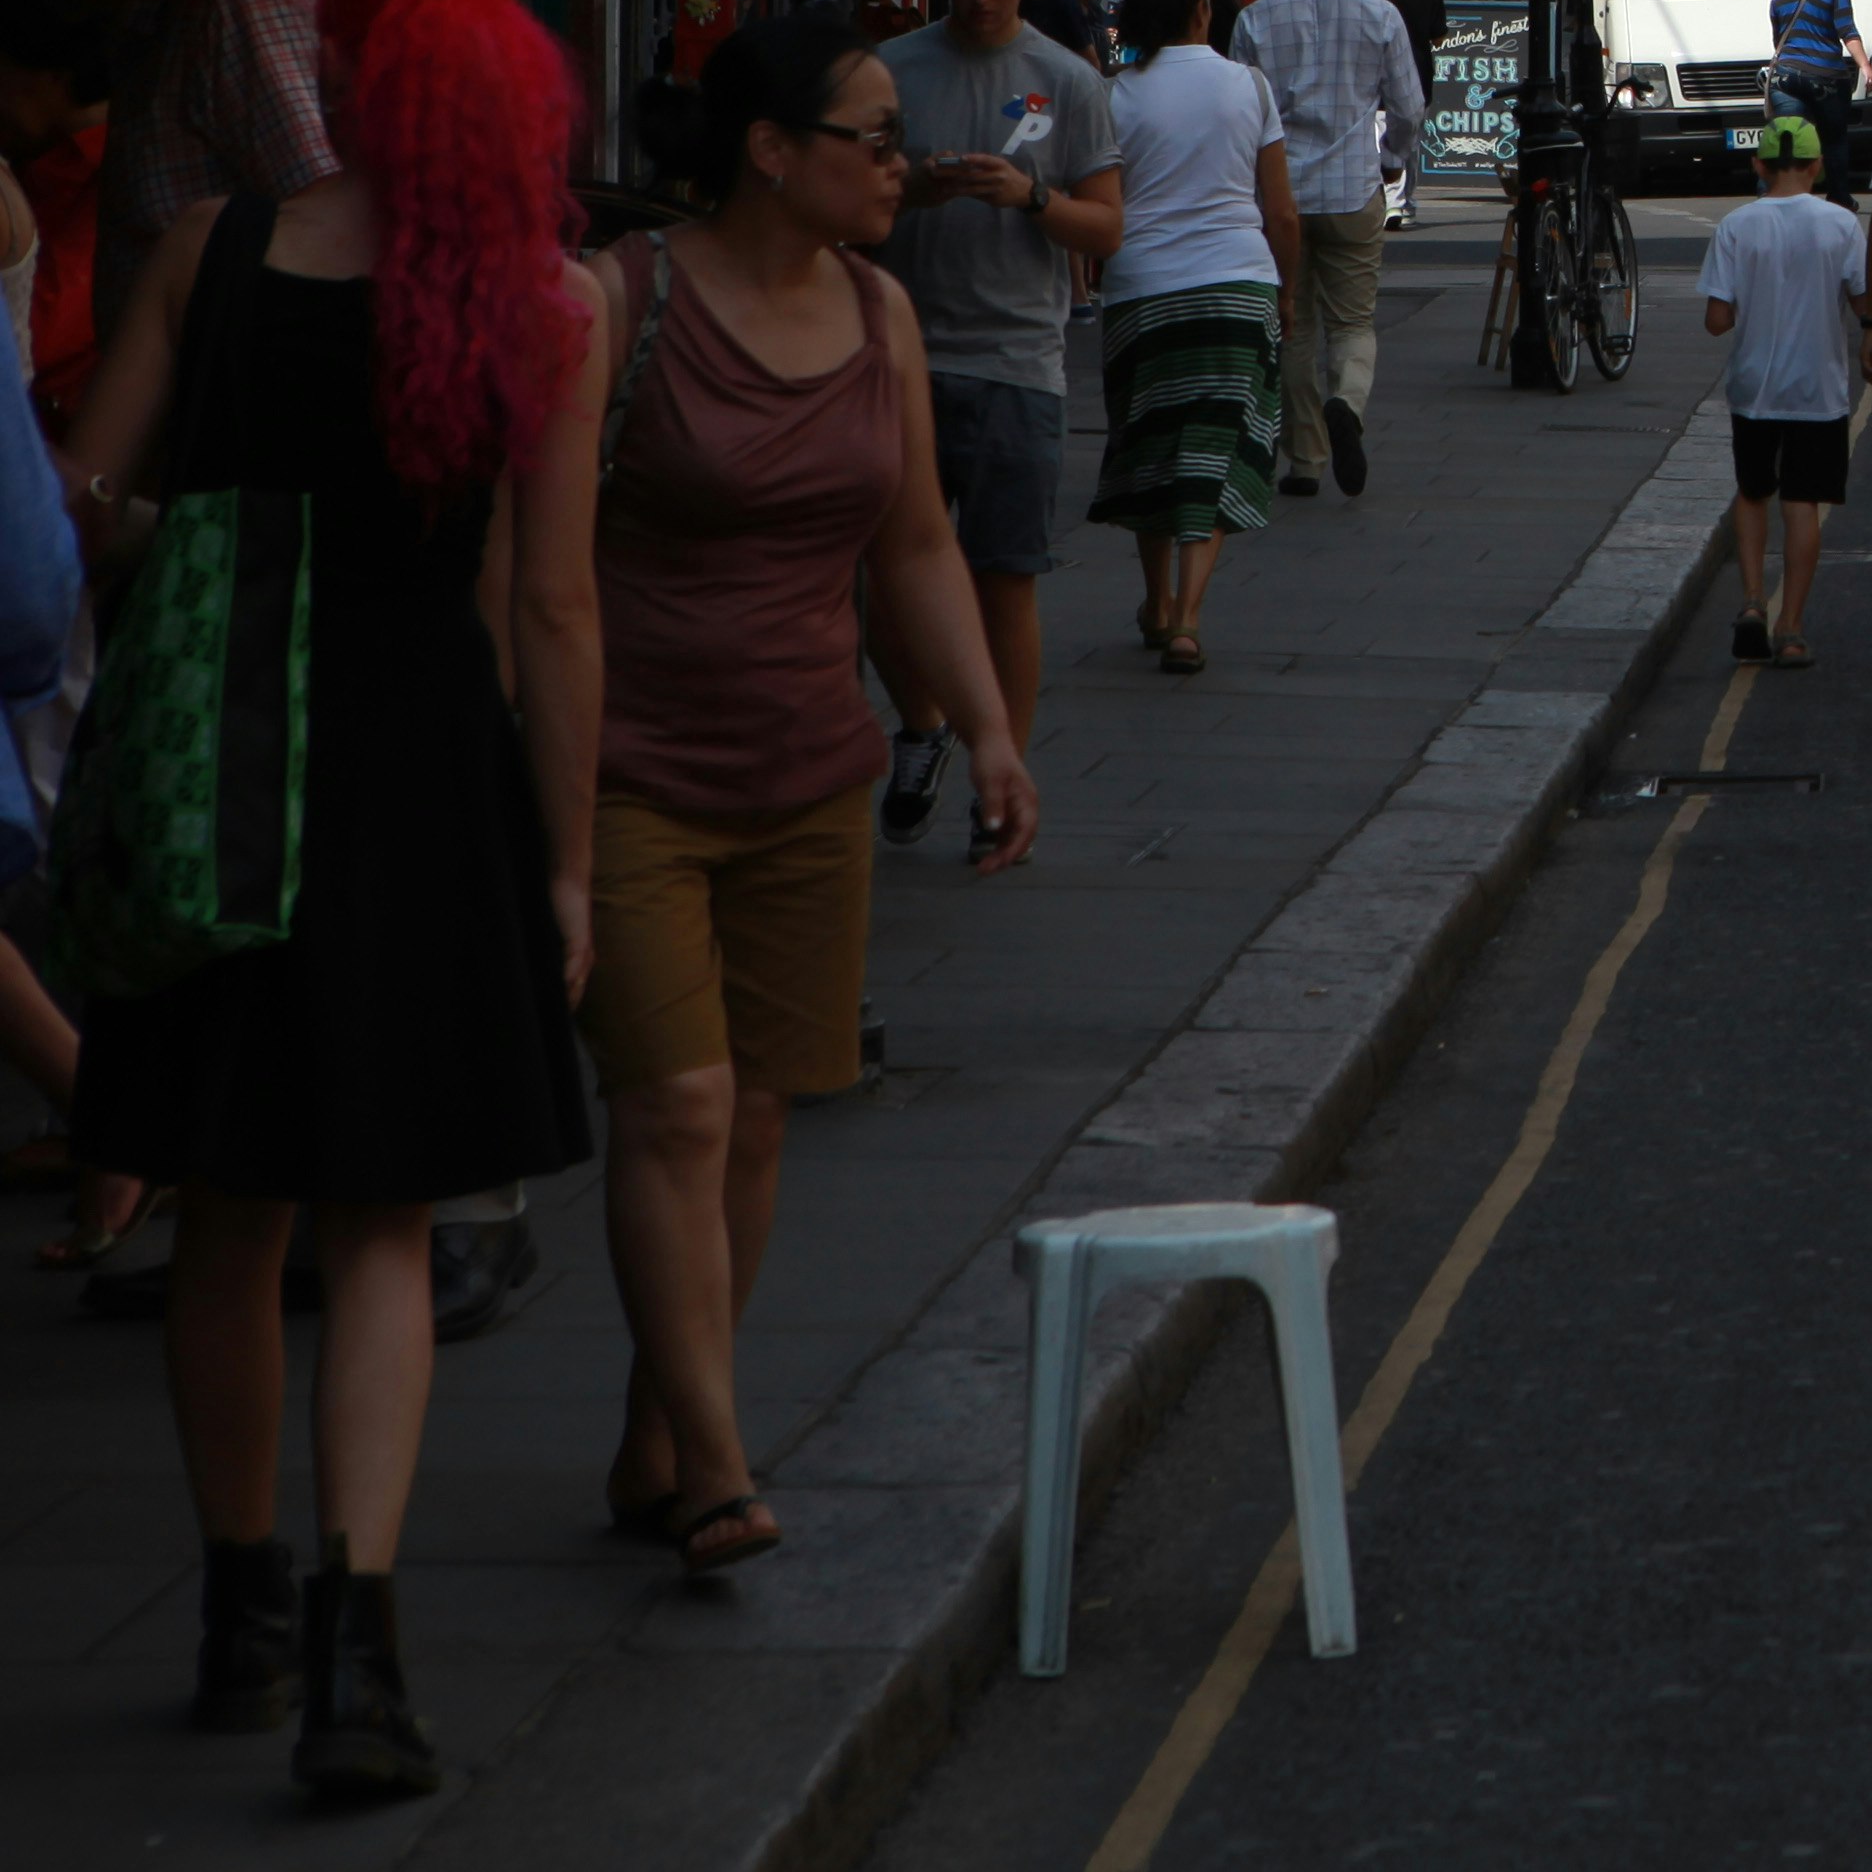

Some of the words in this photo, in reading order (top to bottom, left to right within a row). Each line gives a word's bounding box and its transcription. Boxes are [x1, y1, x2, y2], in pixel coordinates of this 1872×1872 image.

[1431, 29, 1487, 52] ndon's
[1490, 16, 1530, 45] finest
[1433, 56, 1519, 83] FISH
[1465, 83, 1498, 109] &
[1435, 110, 1515, 134] CHIPS
